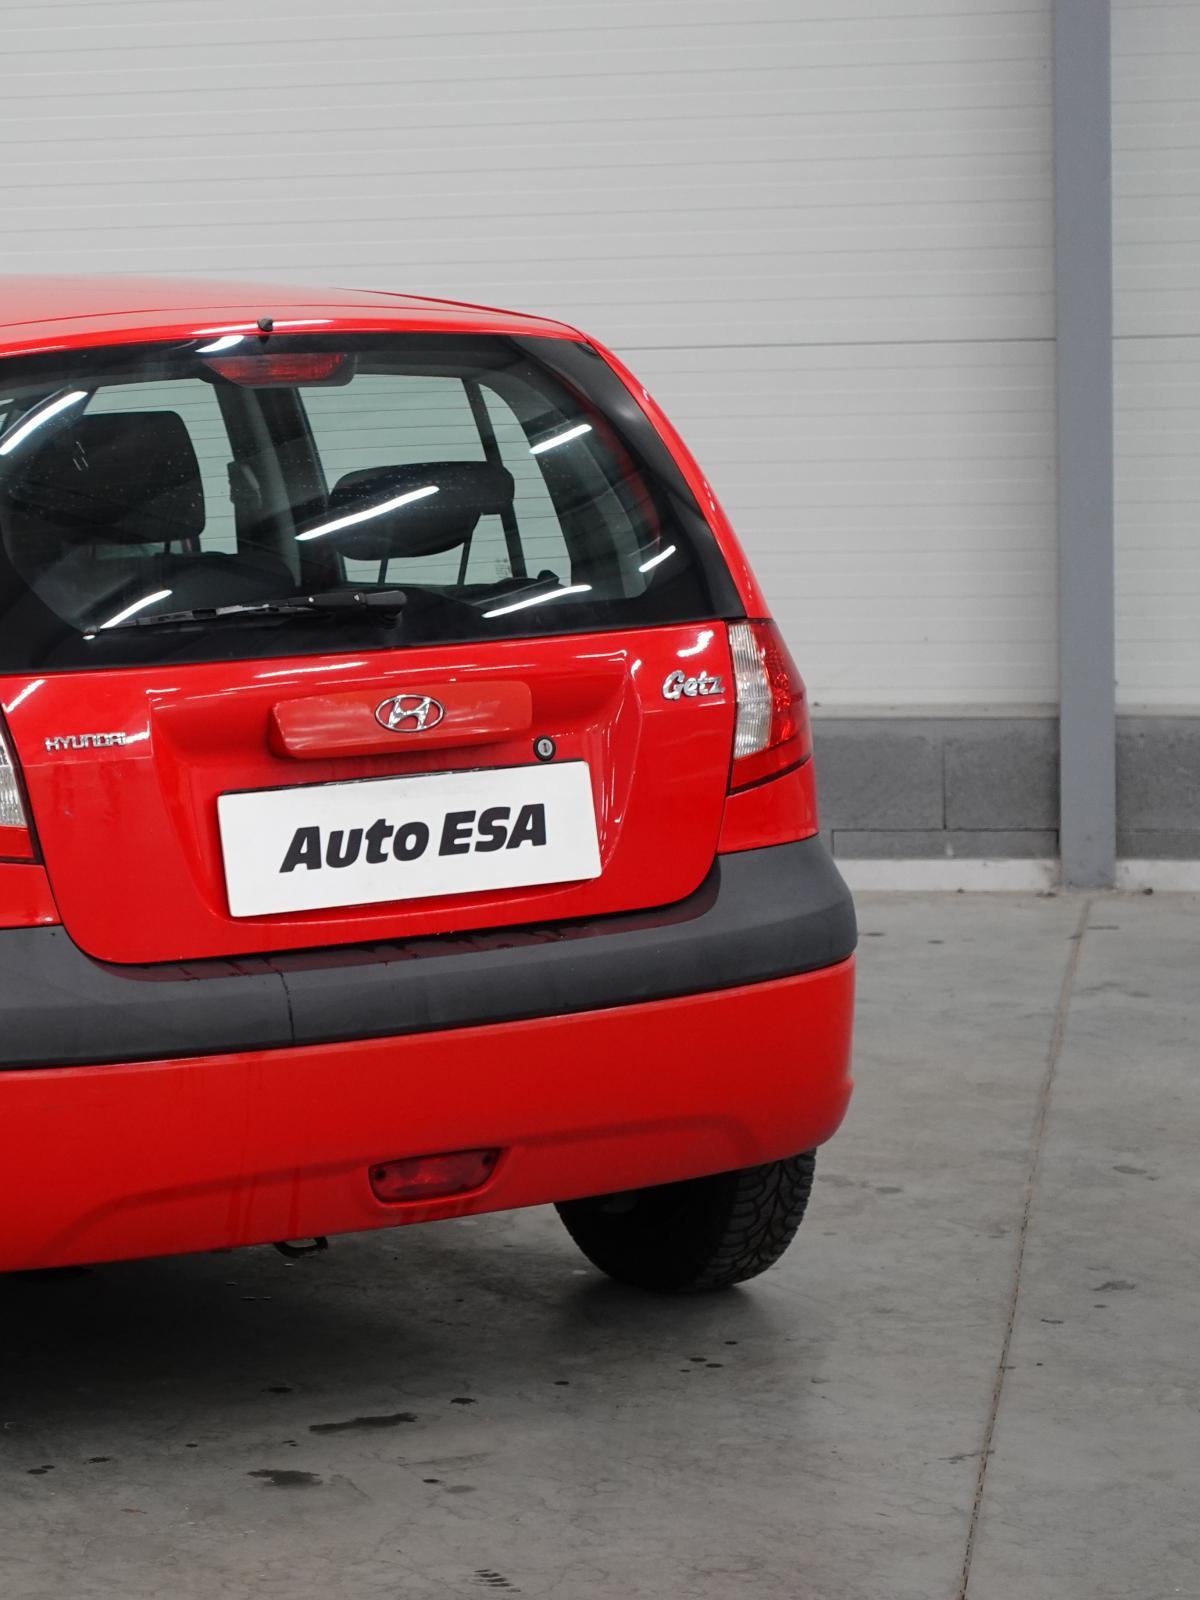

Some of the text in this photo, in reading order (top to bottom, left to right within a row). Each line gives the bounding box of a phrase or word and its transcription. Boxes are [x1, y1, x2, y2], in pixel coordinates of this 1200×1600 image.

[662, 669, 726, 700] Getz
[44, 732, 126, 752] HYUNDAI
[279, 803, 547, 873] Auto ESA
